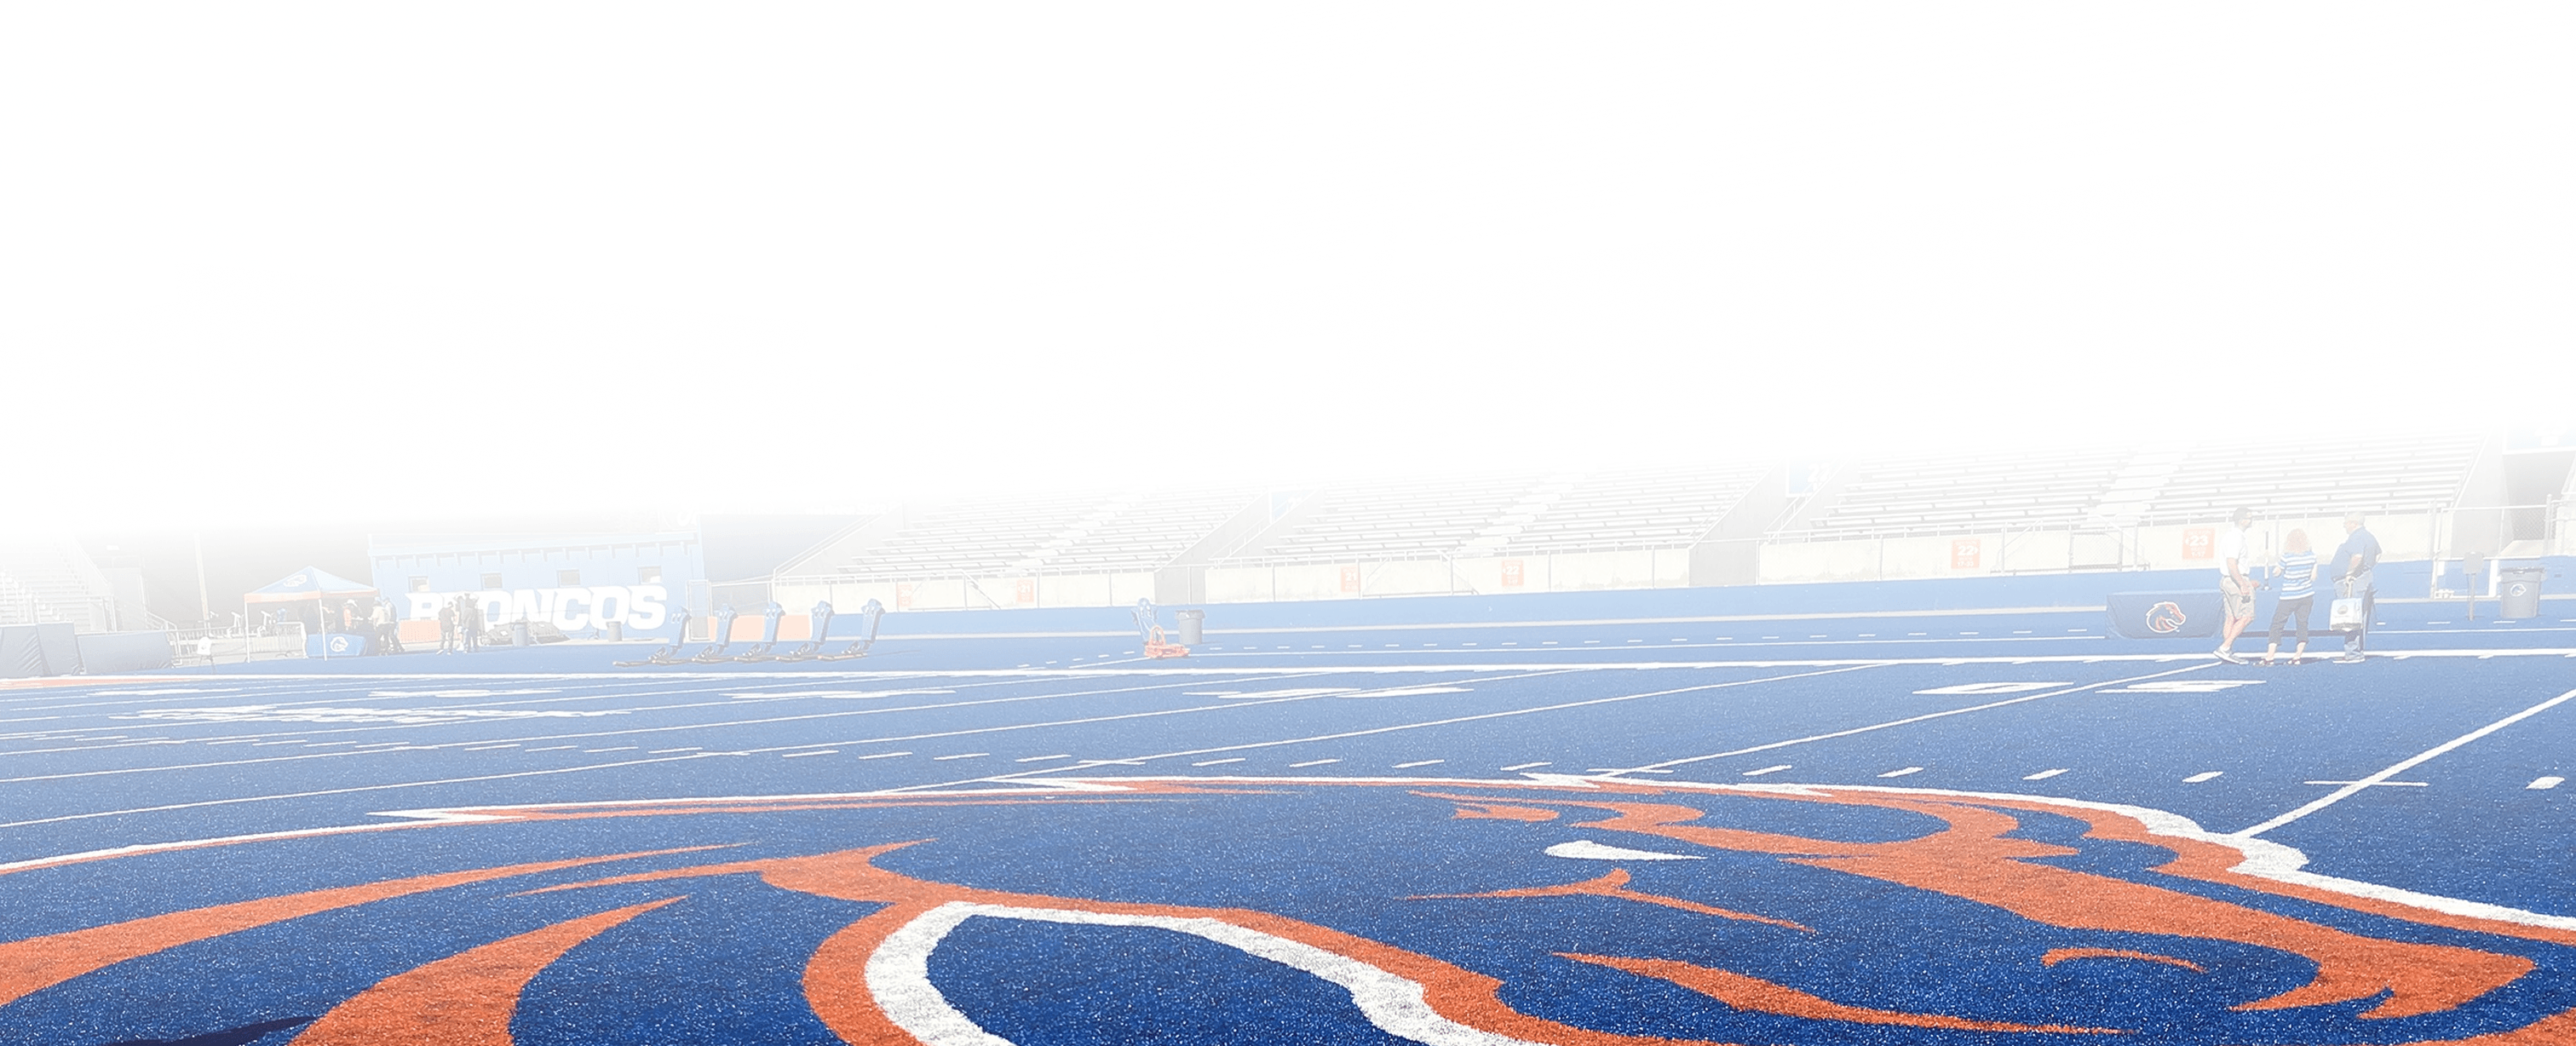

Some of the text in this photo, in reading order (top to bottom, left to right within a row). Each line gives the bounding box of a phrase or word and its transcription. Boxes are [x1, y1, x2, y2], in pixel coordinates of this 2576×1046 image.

[2189, 535, 2208, 546] 23
[1958, 545, 1974, 556] 22
[1506, 566, 1520, 575] 22
[405, 585, 667, 631] BONCOS
